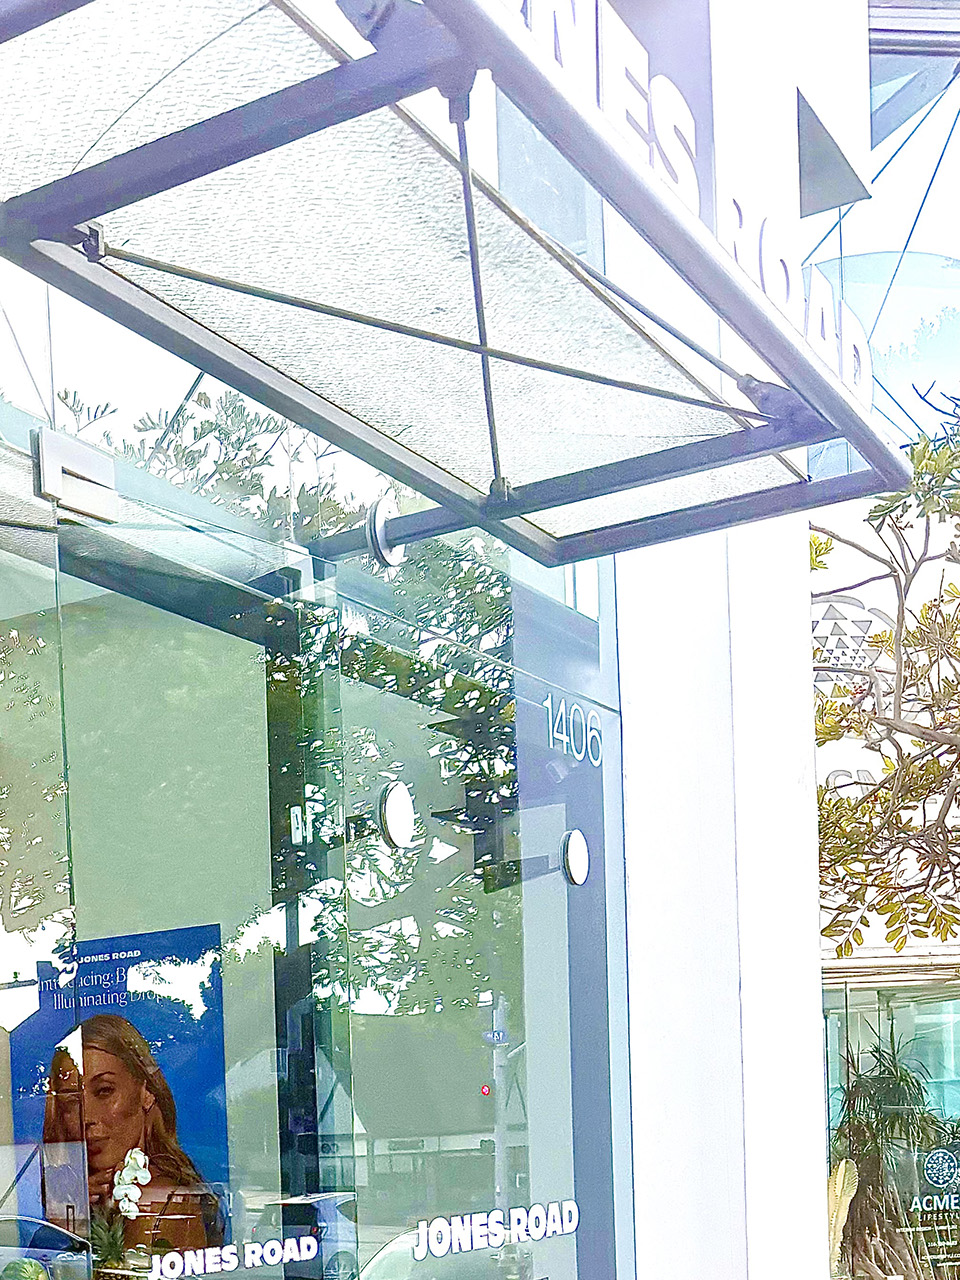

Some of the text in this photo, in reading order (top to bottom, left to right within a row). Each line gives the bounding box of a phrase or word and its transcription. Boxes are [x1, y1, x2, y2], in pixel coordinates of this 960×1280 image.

[543, 692, 603, 768] 1406
[78, 949, 141, 964] JONES ROAD
[910, 1194, 960, 1211] ACME
[918, 1212, 960, 1221] LIFESTYL
[413, 1199, 580, 1261] JONES ROAD
[148, 1236, 318, 1280] JONES ROAD
